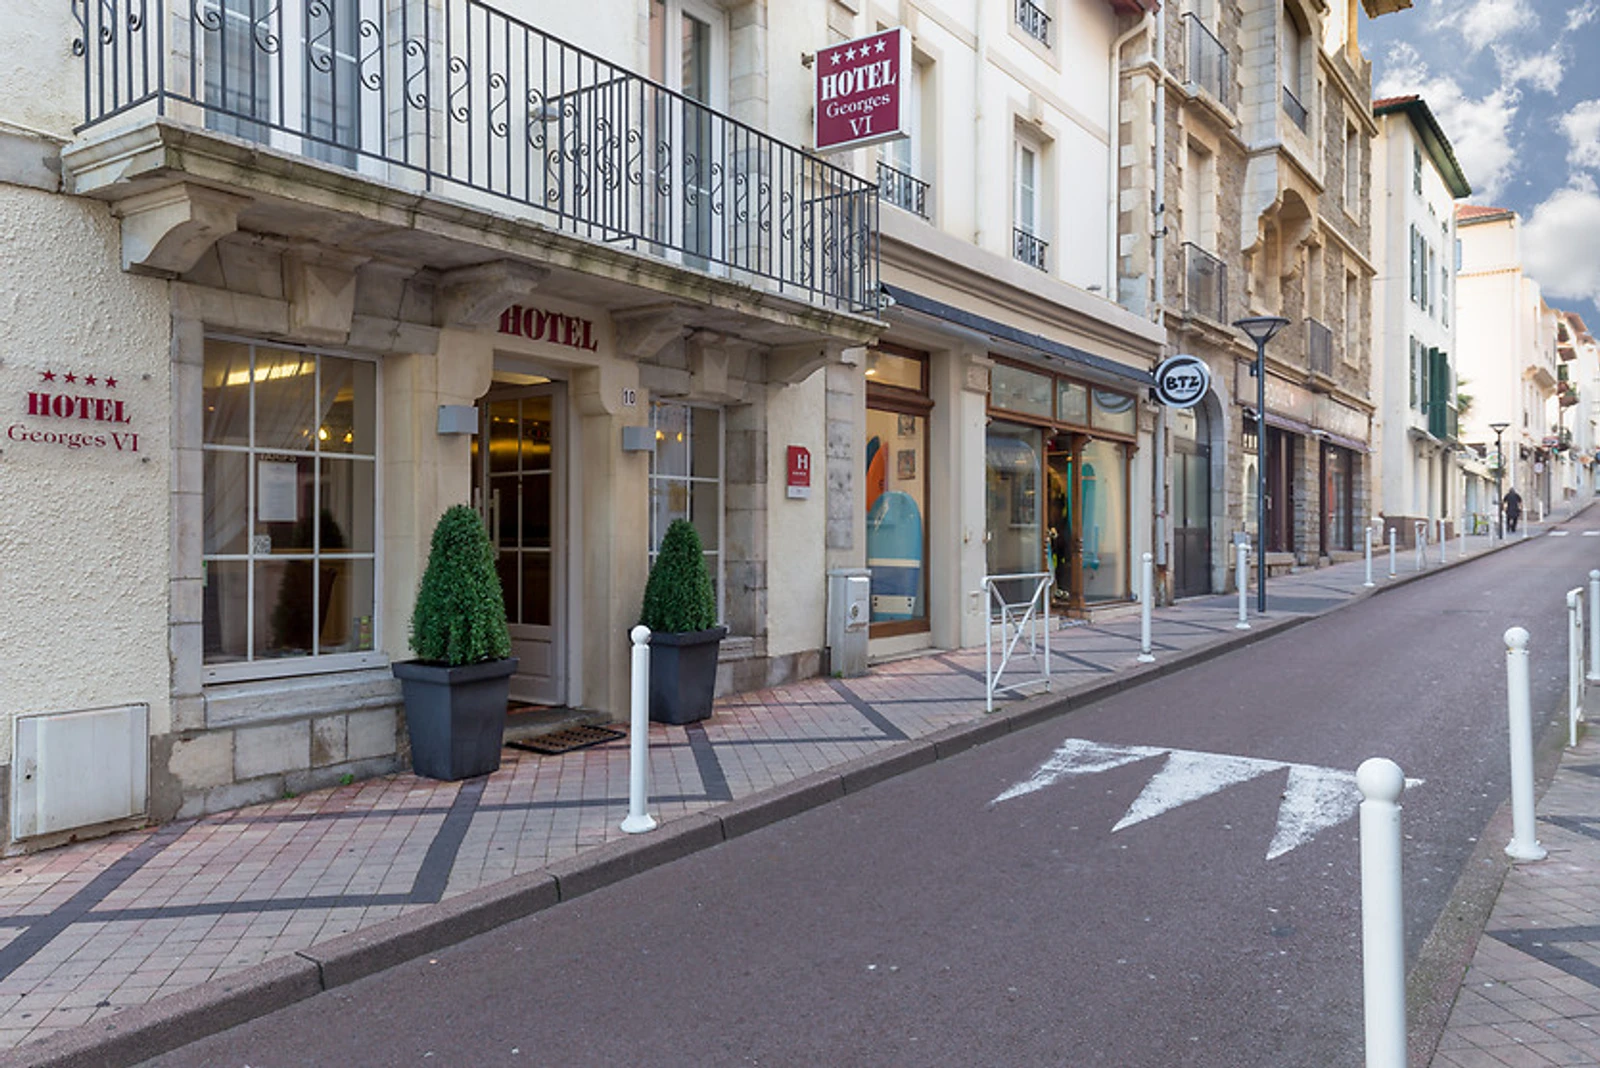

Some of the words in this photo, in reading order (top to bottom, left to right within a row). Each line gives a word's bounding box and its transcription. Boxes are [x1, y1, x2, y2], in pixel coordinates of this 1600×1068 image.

[821, 59, 897, 101] HOTEL
[826, 93, 890, 118] Georges
[849, 115, 873, 136] VI
[497, 303, 598, 352] HOTEL
[1166, 376, 1200, 390] BTZ
[27, 392, 132, 424] HOTEL
[624, 391, 636, 404] 10
[7, 424, 106, 449] Georges
[111, 432, 140, 452] VI
[797, 454, 808, 469] H
